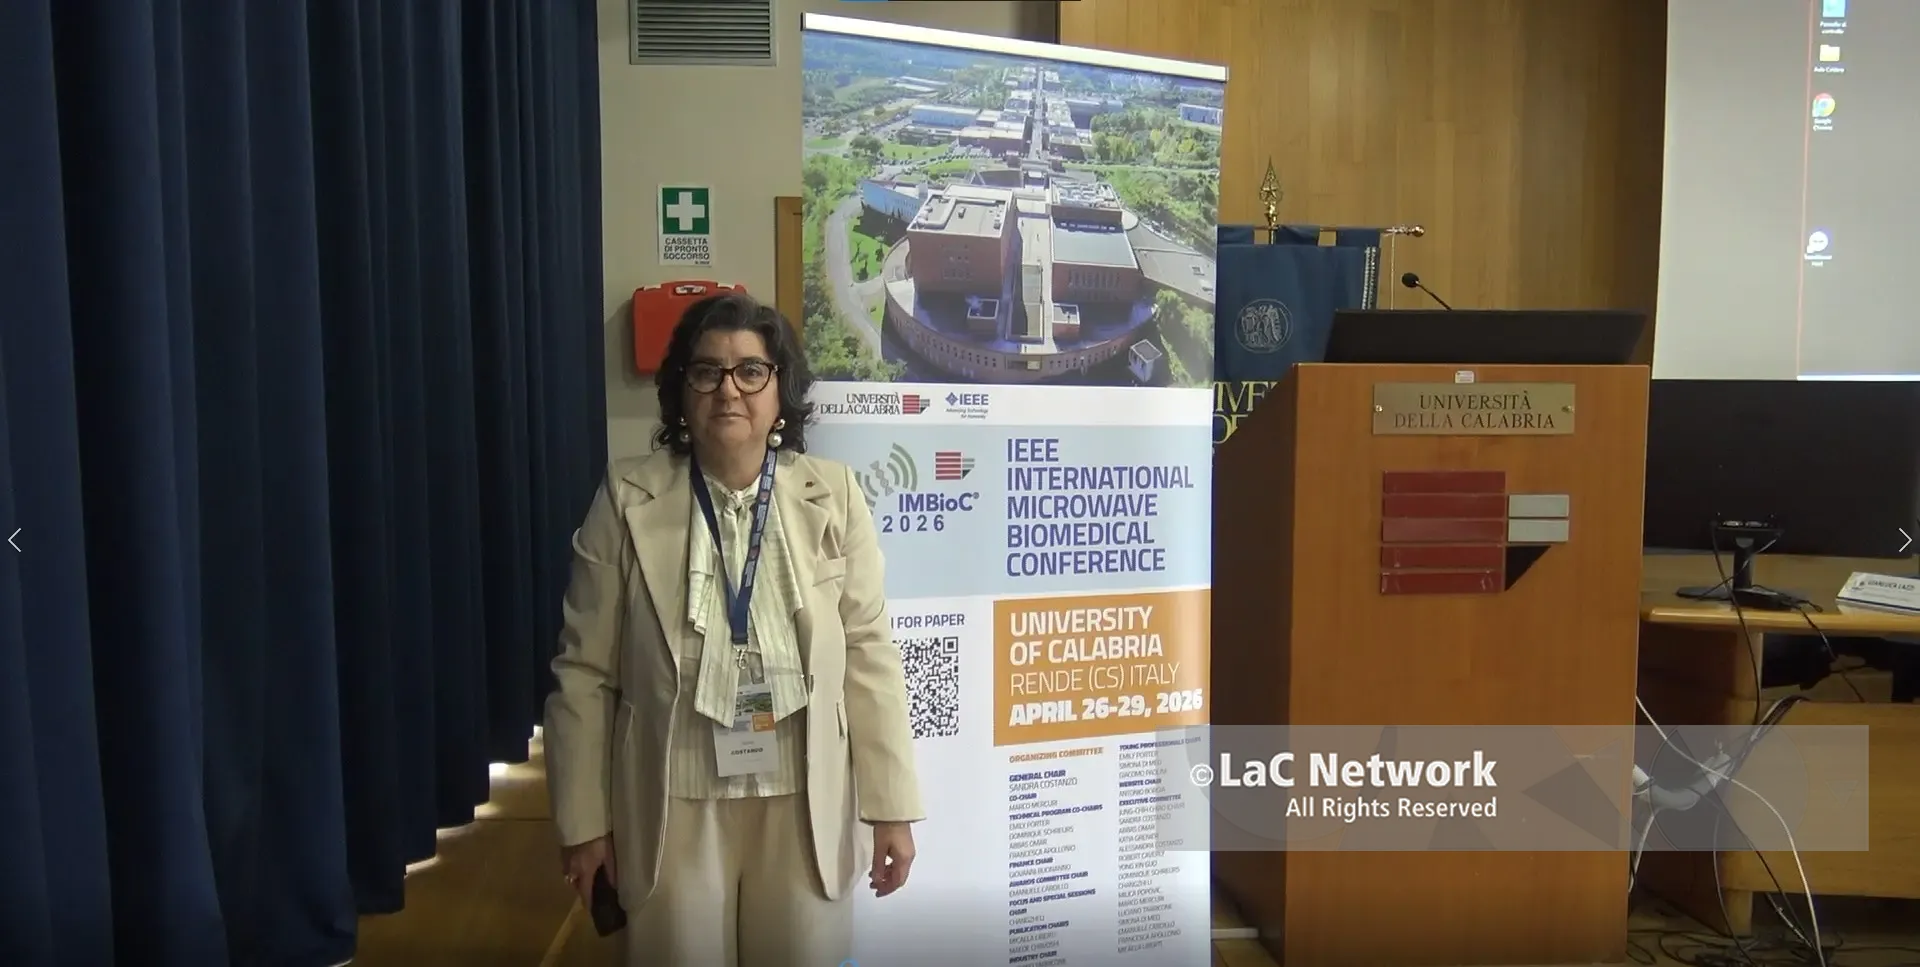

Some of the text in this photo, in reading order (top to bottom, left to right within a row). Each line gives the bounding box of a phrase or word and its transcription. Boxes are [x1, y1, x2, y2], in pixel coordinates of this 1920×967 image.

[665, 237, 708, 245] CASSETTA
[674, 245, 709, 253] PRONTO
[663, 252, 710, 260] SOCCORSO
[846, 392, 900, 405] UNIVERSITÀ
[960, 393, 989, 406] IEEE
[1419, 390, 1532, 410] UNIVERSITÀ
[820, 404, 901, 415] DELLA CALABRIA
[1395, 413, 1555, 429] DELLA CALABRIA
[1007, 438, 1060, 463] IEEE
[1007, 465, 1194, 491] INTERNATIONAL
[1007, 493, 1158, 519] MICROWAVE
[882, 514, 944, 533] 2026
[1007, 521, 1155, 548] BIOMEDICAL
[1006, 548, 1166, 577] CONFERENCE
[897, 616, 922, 629] FOR
[924, 613, 965, 628] PAPER
[1010, 606, 1153, 637] UNIVERSITY
[1010, 634, 1164, 666] OF CALABRIA
[1010, 662, 1181, 696] RENDE (CS) ITALY
[1009, 688, 1204, 727] APRIL 26-29, 2026
[1009, 747, 1104, 763] ORGANIZING COMMITTEE
[1009, 769, 1066, 782] GENERAL CHAIR
[1009, 777, 1078, 792] SANDRA COSTANZO
[1009, 793, 1037, 802] CO-CHAIR
